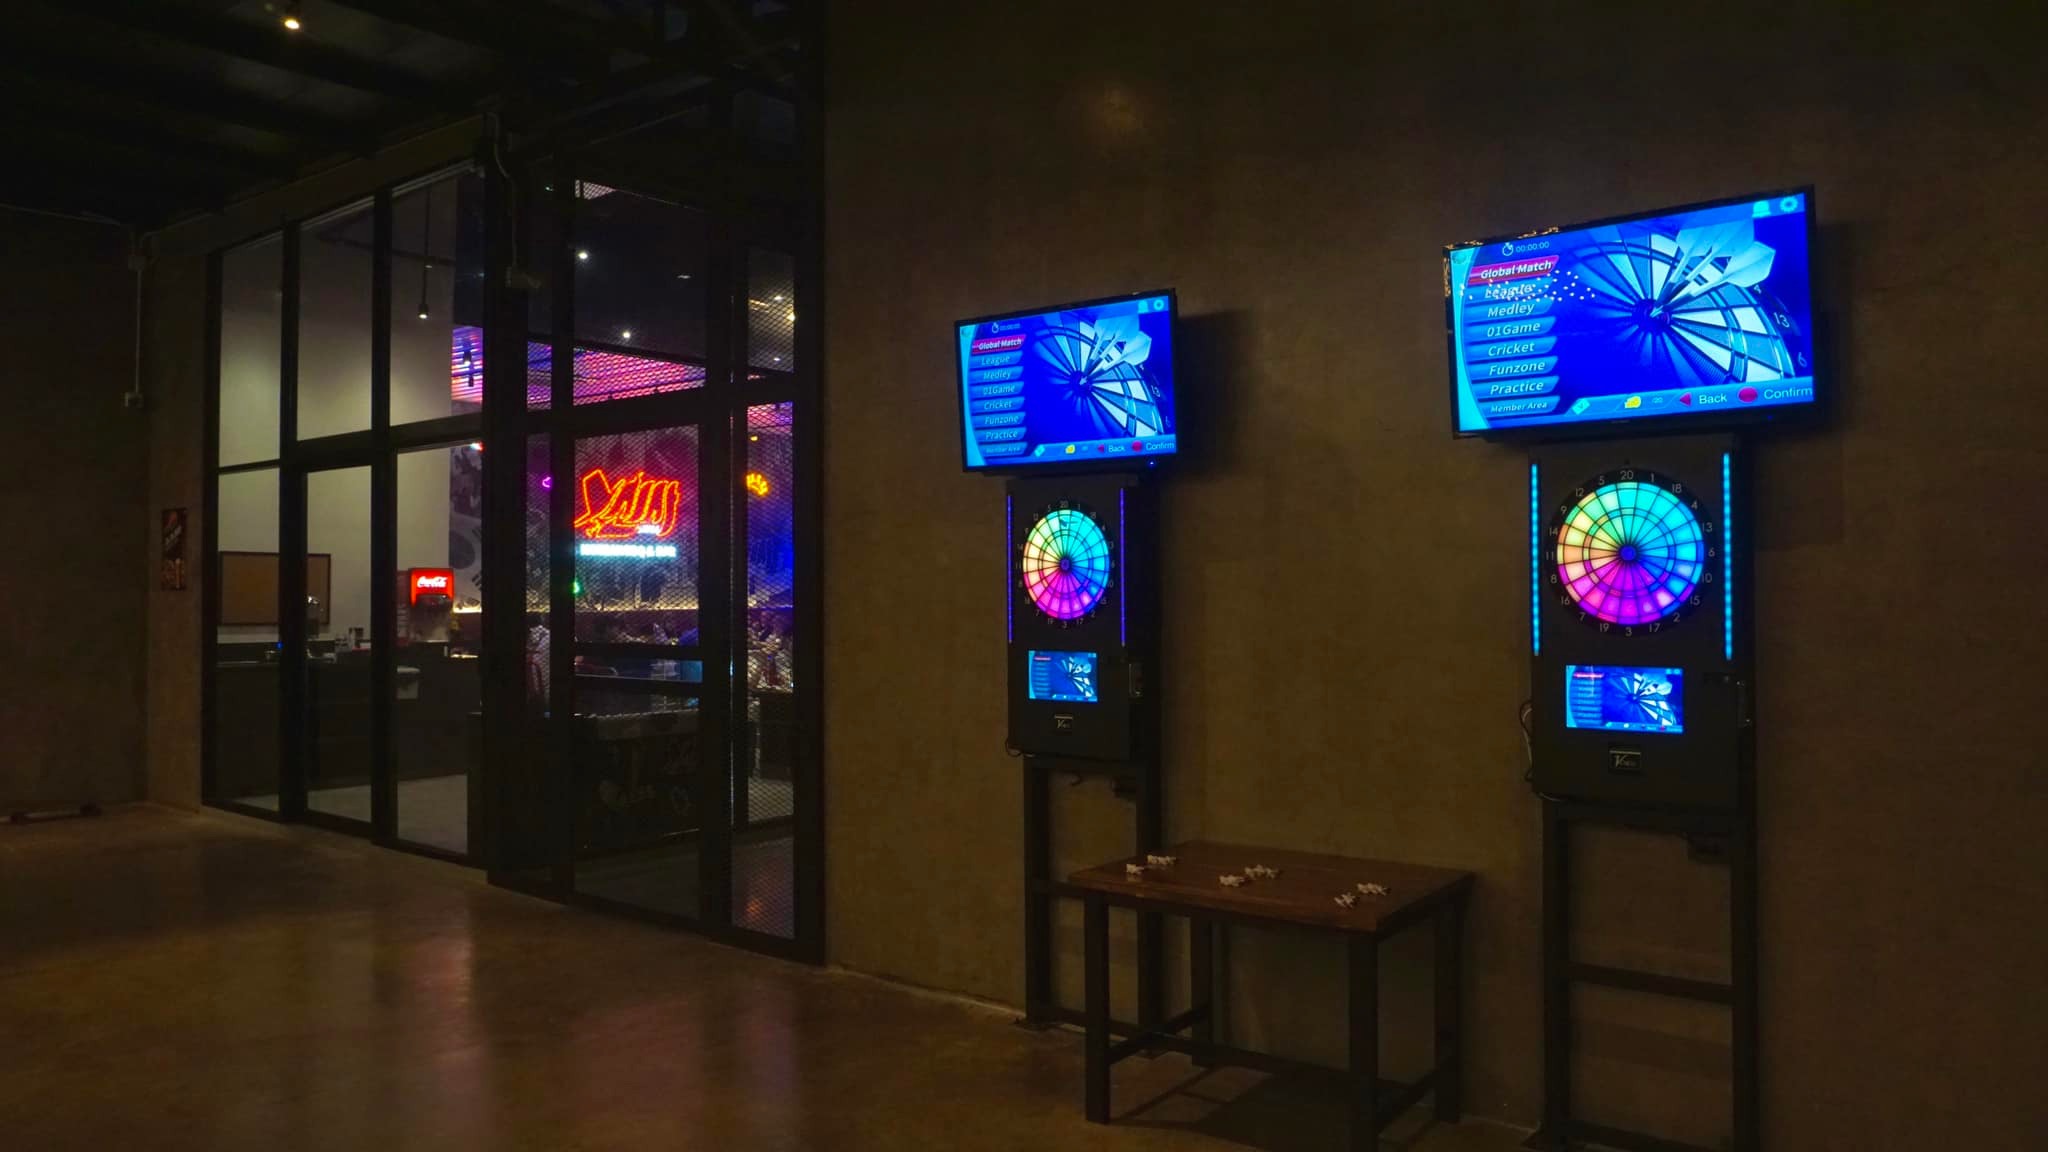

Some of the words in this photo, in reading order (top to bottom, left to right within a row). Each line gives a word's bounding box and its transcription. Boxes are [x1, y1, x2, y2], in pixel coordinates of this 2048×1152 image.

[1481, 265, 1515, 279] Global
[1517, 260, 1552, 273] Match
[1488, 303, 1535, 318] Medley
[1487, 322, 1541, 337] 01Game
[1488, 342, 1535, 356] Cricket
[1489, 361, 1546, 376] Funzone
[1490, 381, 1544, 395] Practice
[1699, 393, 1728, 404] Back
[1764, 387, 1813, 400] Confirm
[1491, 403, 1525, 413] Member
[1527, 402, 1548, 410] Area
[1620, 470, 1634, 480] 20
[1575, 488, 1585, 497] 12
[1672, 483, 1682, 493] 18
[1548, 527, 1558, 536] 14
[1702, 522, 1713, 532] 13
[1546, 551, 1555, 560] 11
[1701, 573, 1713, 583] 10
[1561, 596, 1570, 605] 16
[1690, 596, 1701, 606] 15
[1600, 623, 1610, 633] 19
[1649, 623, 1661, 633] 17
